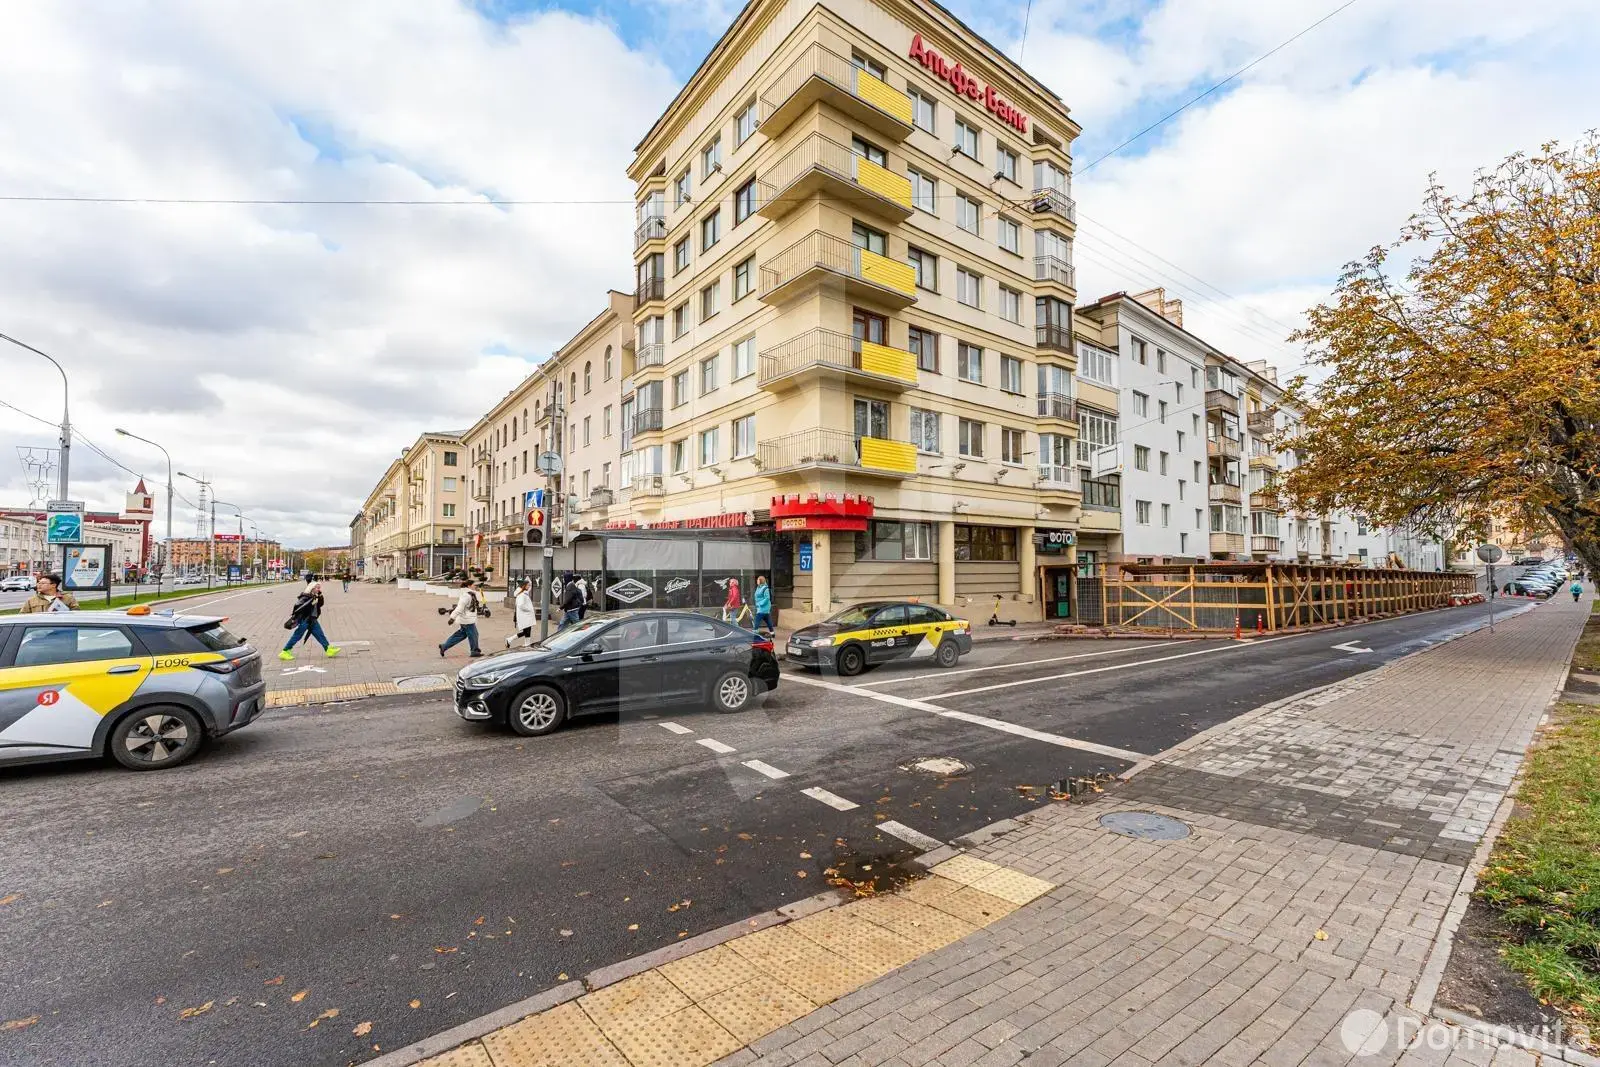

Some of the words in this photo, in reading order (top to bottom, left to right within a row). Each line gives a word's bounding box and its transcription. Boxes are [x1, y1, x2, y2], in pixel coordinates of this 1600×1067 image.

[1050, 532, 1072, 544] ФОТО
[801, 555, 811, 569] 57
[155, 657, 190, 669] E096
[42, 691, 53, 704] Я
